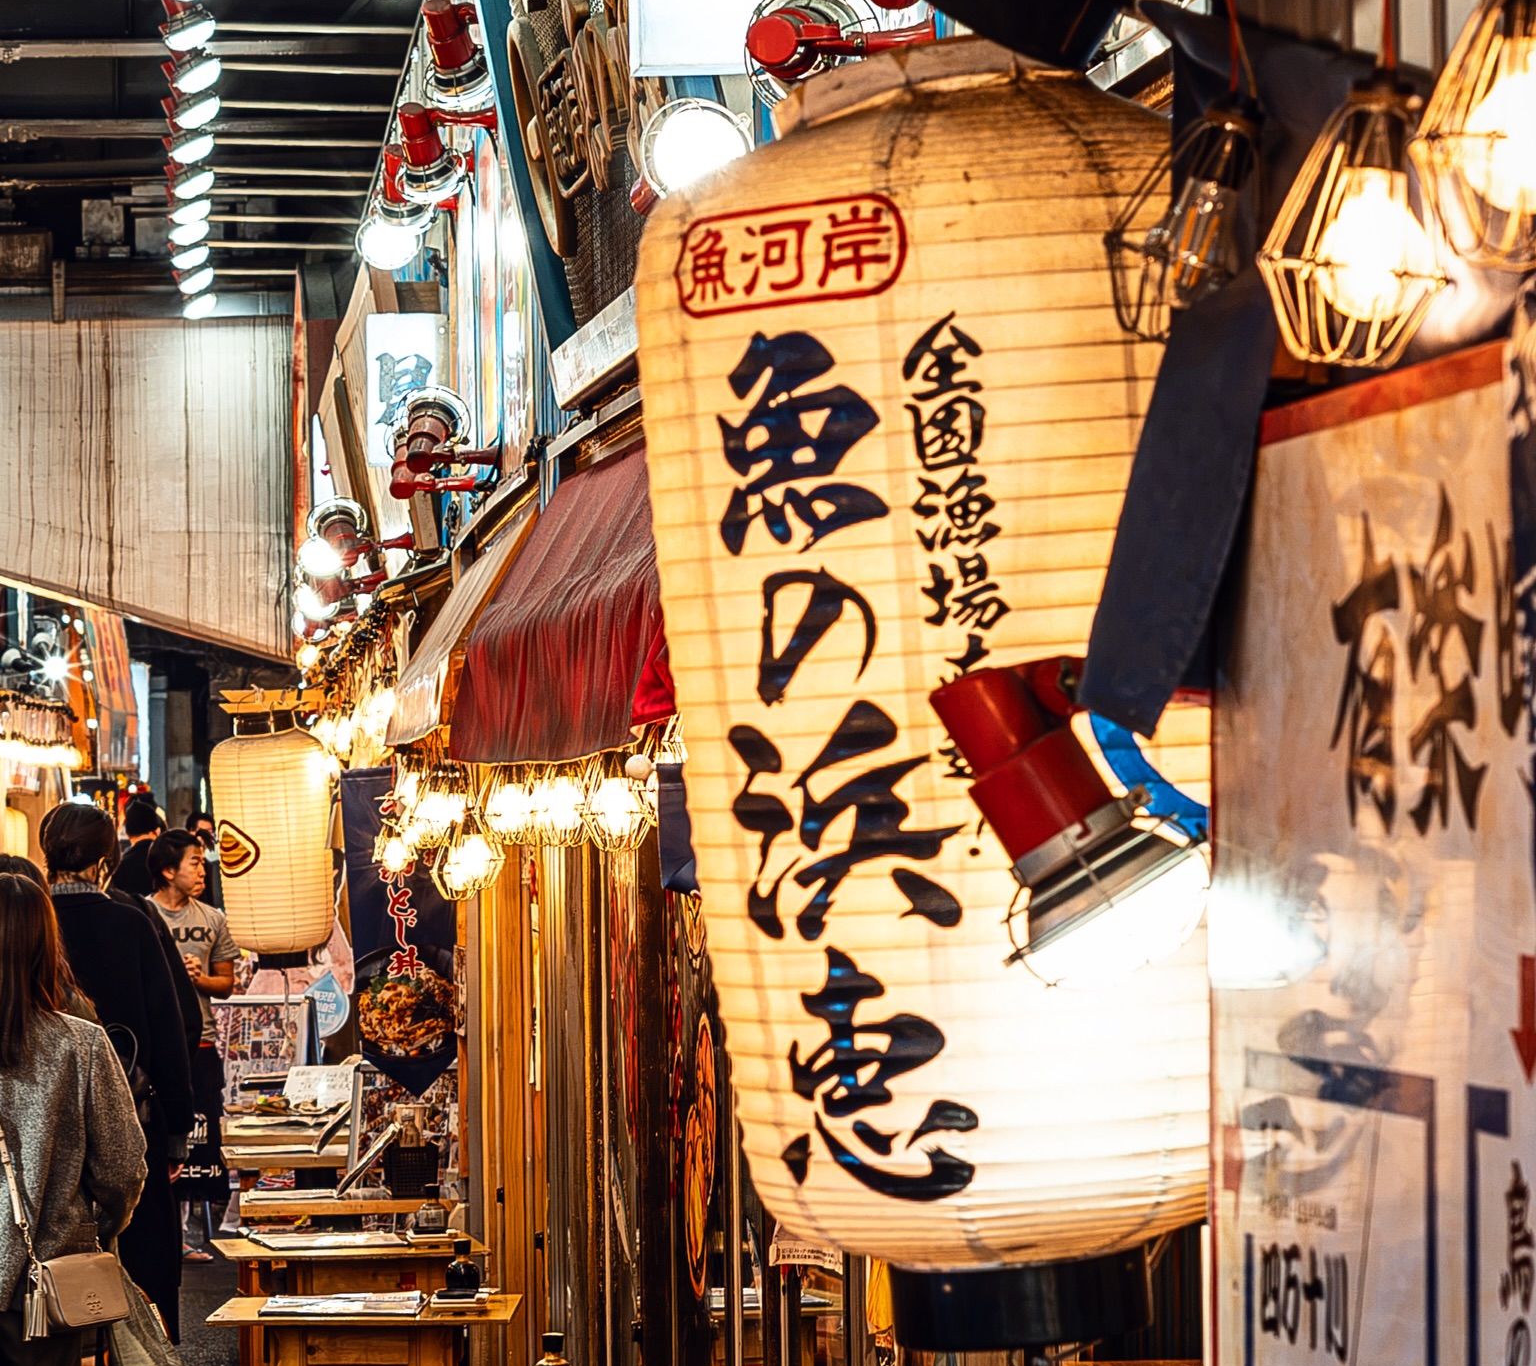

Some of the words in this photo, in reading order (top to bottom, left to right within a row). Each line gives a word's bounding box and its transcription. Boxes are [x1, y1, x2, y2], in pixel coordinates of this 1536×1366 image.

[686, 209, 898, 304] 魚河岸
[1260, 1243, 1349, 1363] 四万十川
